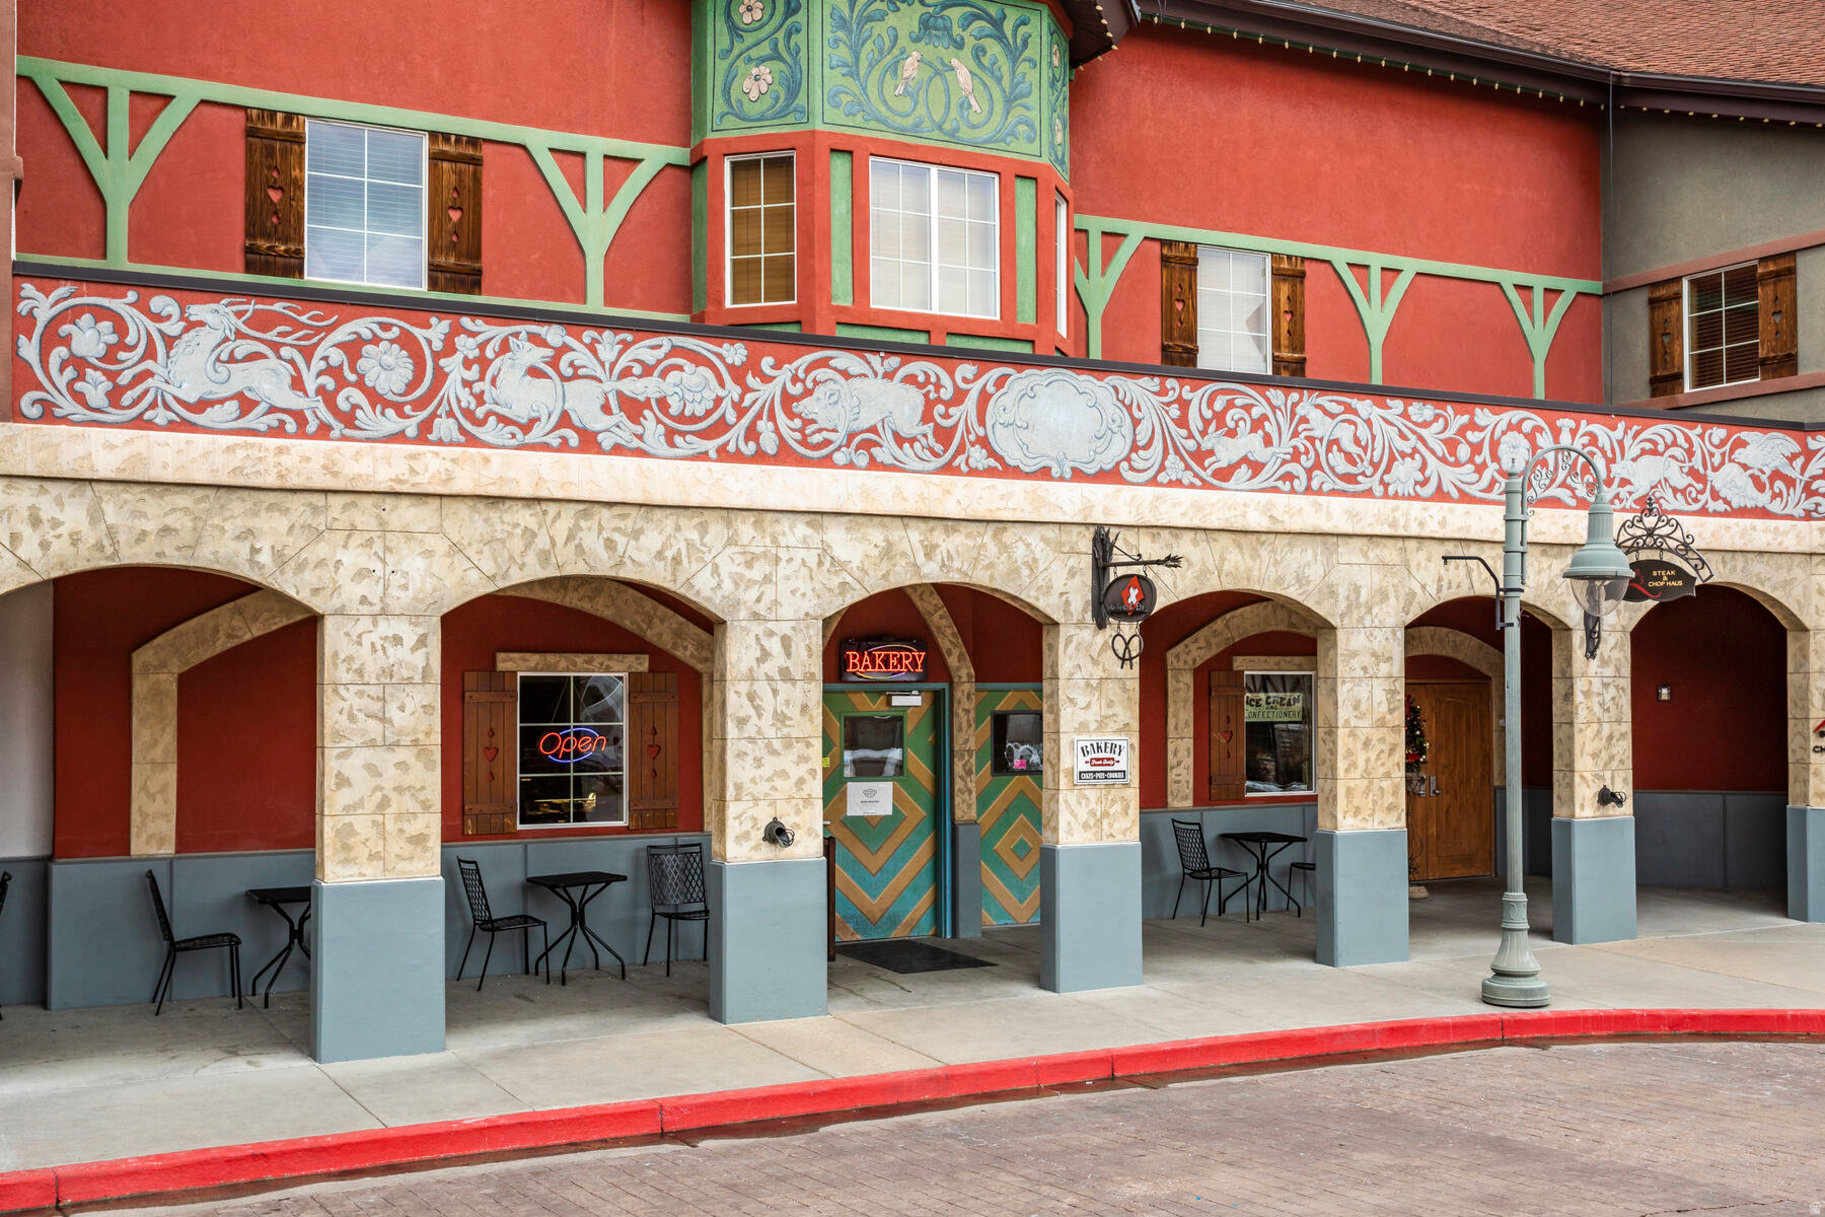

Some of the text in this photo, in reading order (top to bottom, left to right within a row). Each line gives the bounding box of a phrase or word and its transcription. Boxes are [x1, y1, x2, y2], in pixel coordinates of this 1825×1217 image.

[845, 650, 926, 672] BAKERY
[1246, 695, 1262, 707] ICE
[540, 732, 607, 759] Open
[1080, 741, 1126, 758] BAKERY
